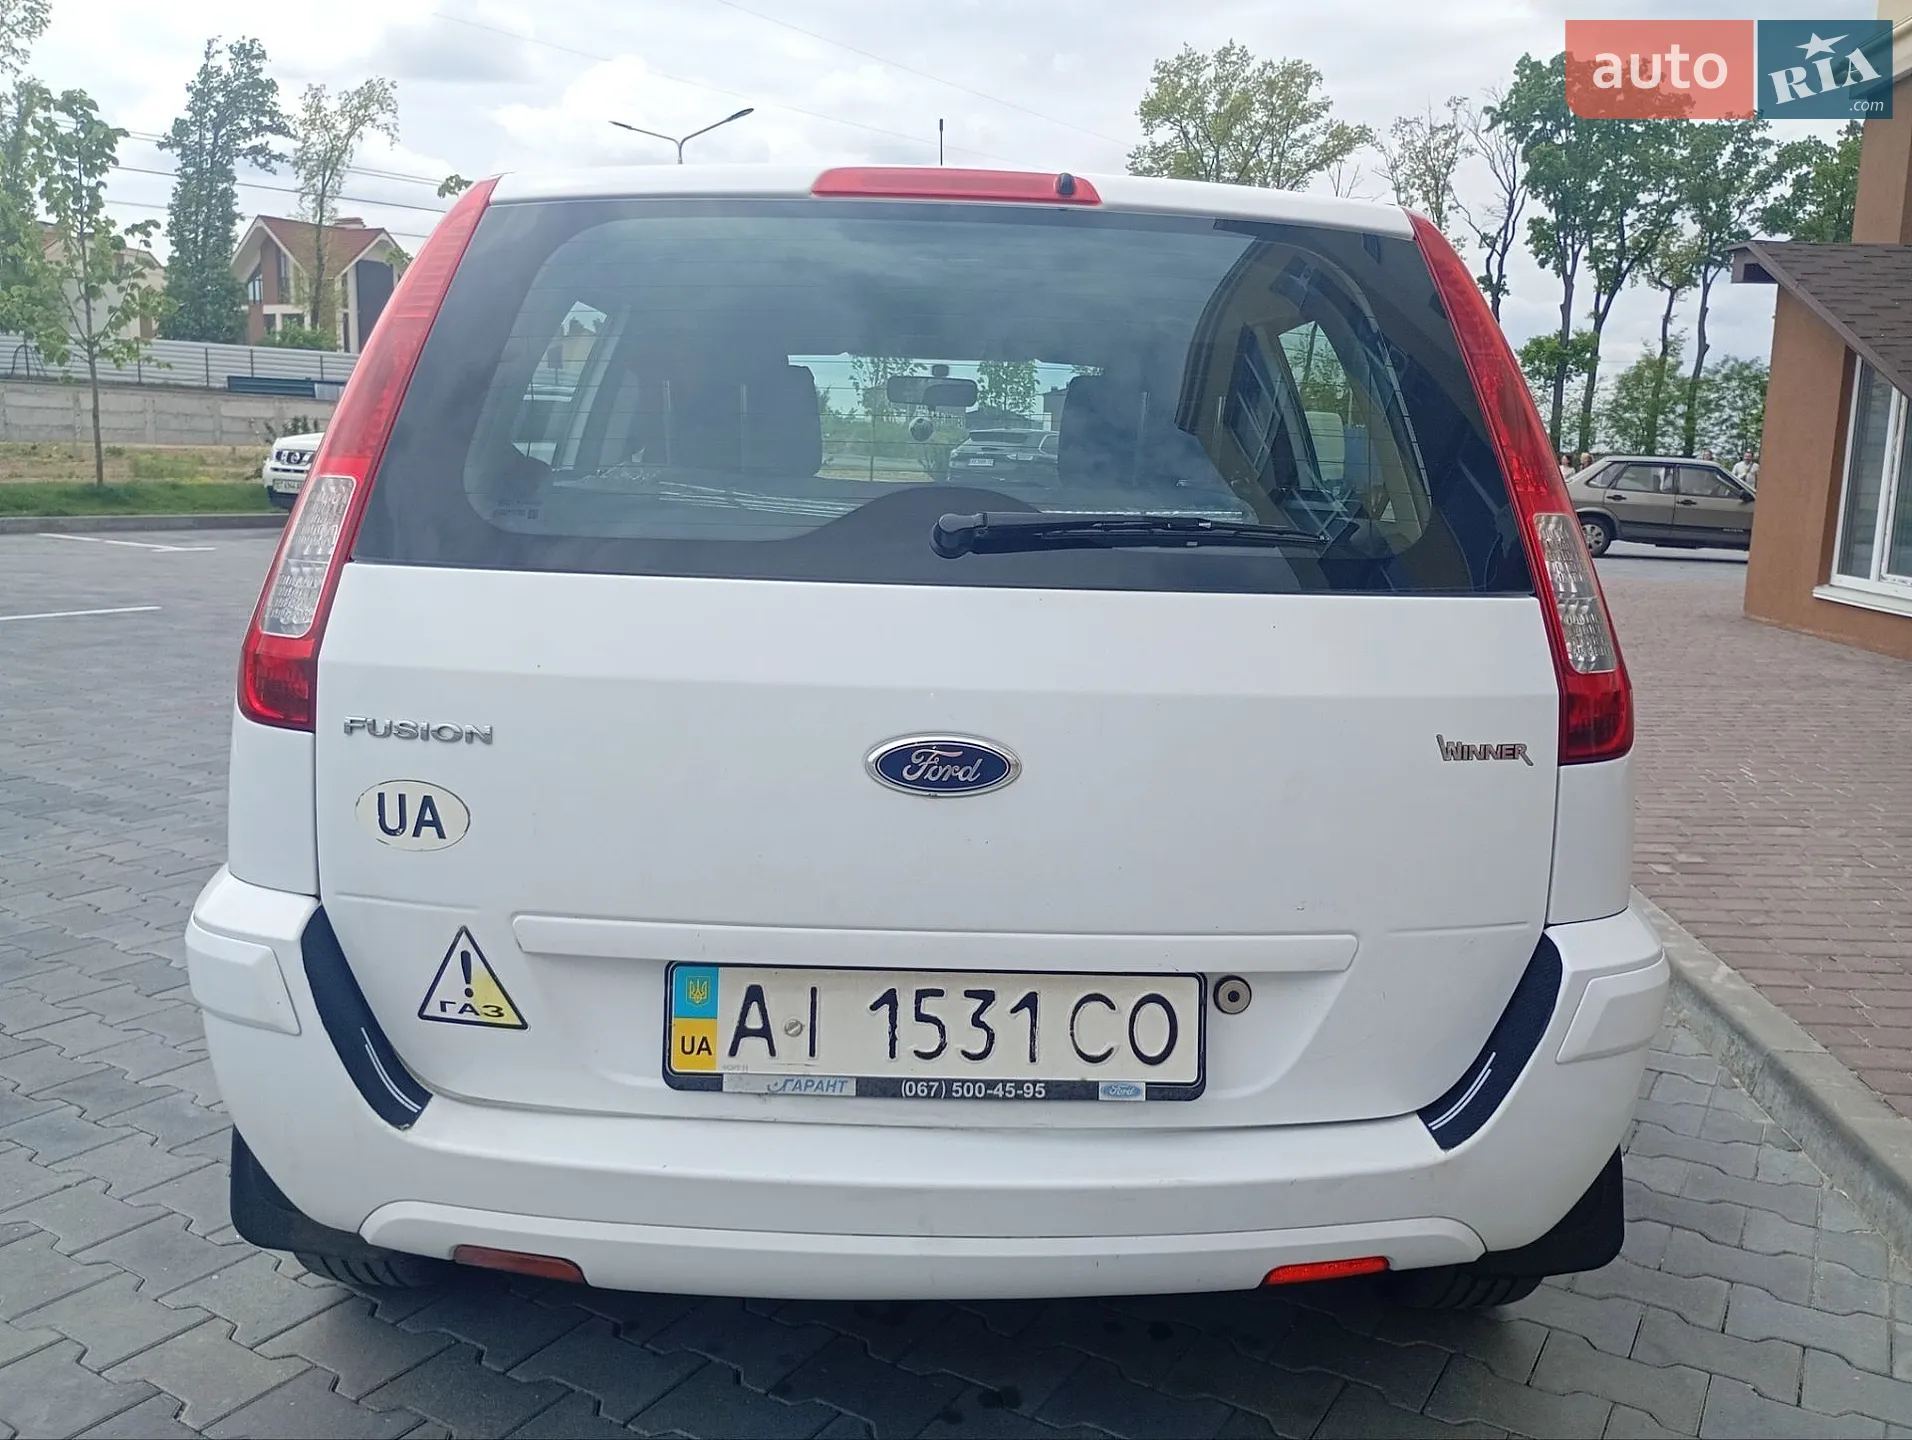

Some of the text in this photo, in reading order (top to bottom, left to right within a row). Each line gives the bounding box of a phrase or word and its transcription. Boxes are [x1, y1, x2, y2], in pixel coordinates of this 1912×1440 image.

[343, 715, 493, 745] FUSION
[902, 746, 983, 782] Ford
[377, 791, 447, 839] UA
[439, 1000, 506, 1019] ГАЗ
[869, 987, 1038, 1064] 1531
[680, 1037, 713, 1056] UA
[778, 1077, 849, 1094] ГАРАНТ
[901, 1081, 1046, 1099] (067) 500-45-95
